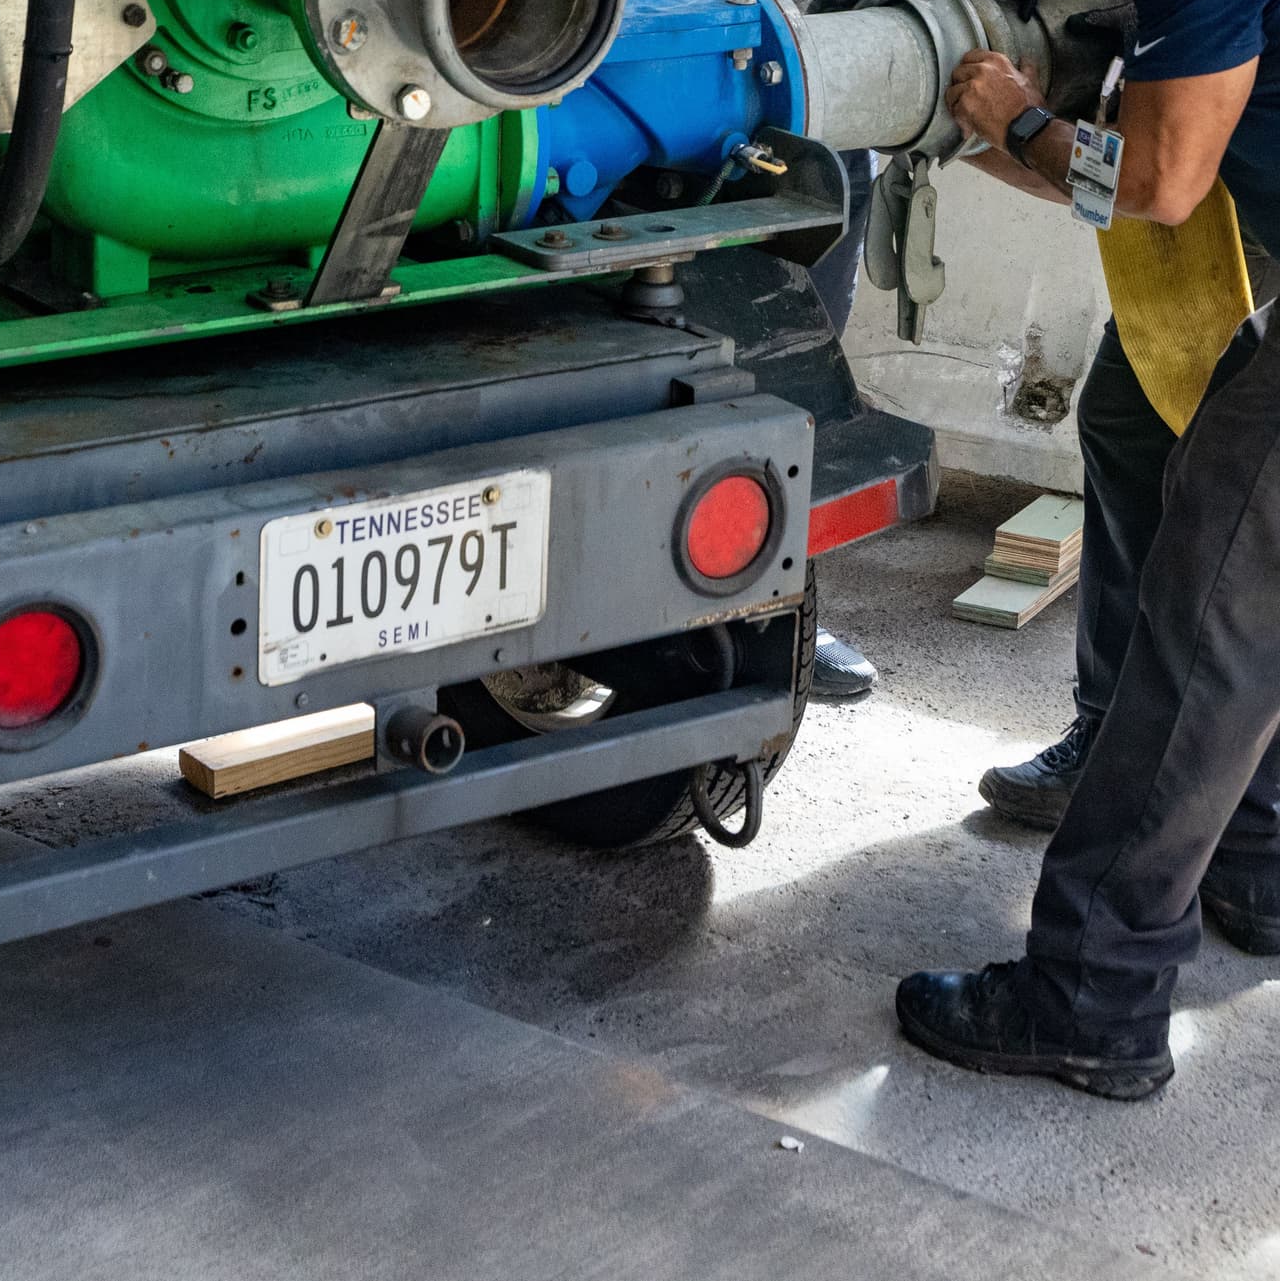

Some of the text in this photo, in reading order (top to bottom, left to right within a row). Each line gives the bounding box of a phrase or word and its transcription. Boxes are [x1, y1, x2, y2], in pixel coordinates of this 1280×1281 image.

[1075, 203, 1108, 225] Plumber
[336, 493, 481, 544] TENNESSEE
[292, 521, 518, 634] 010979T
[378, 621, 430, 648] SEMI
